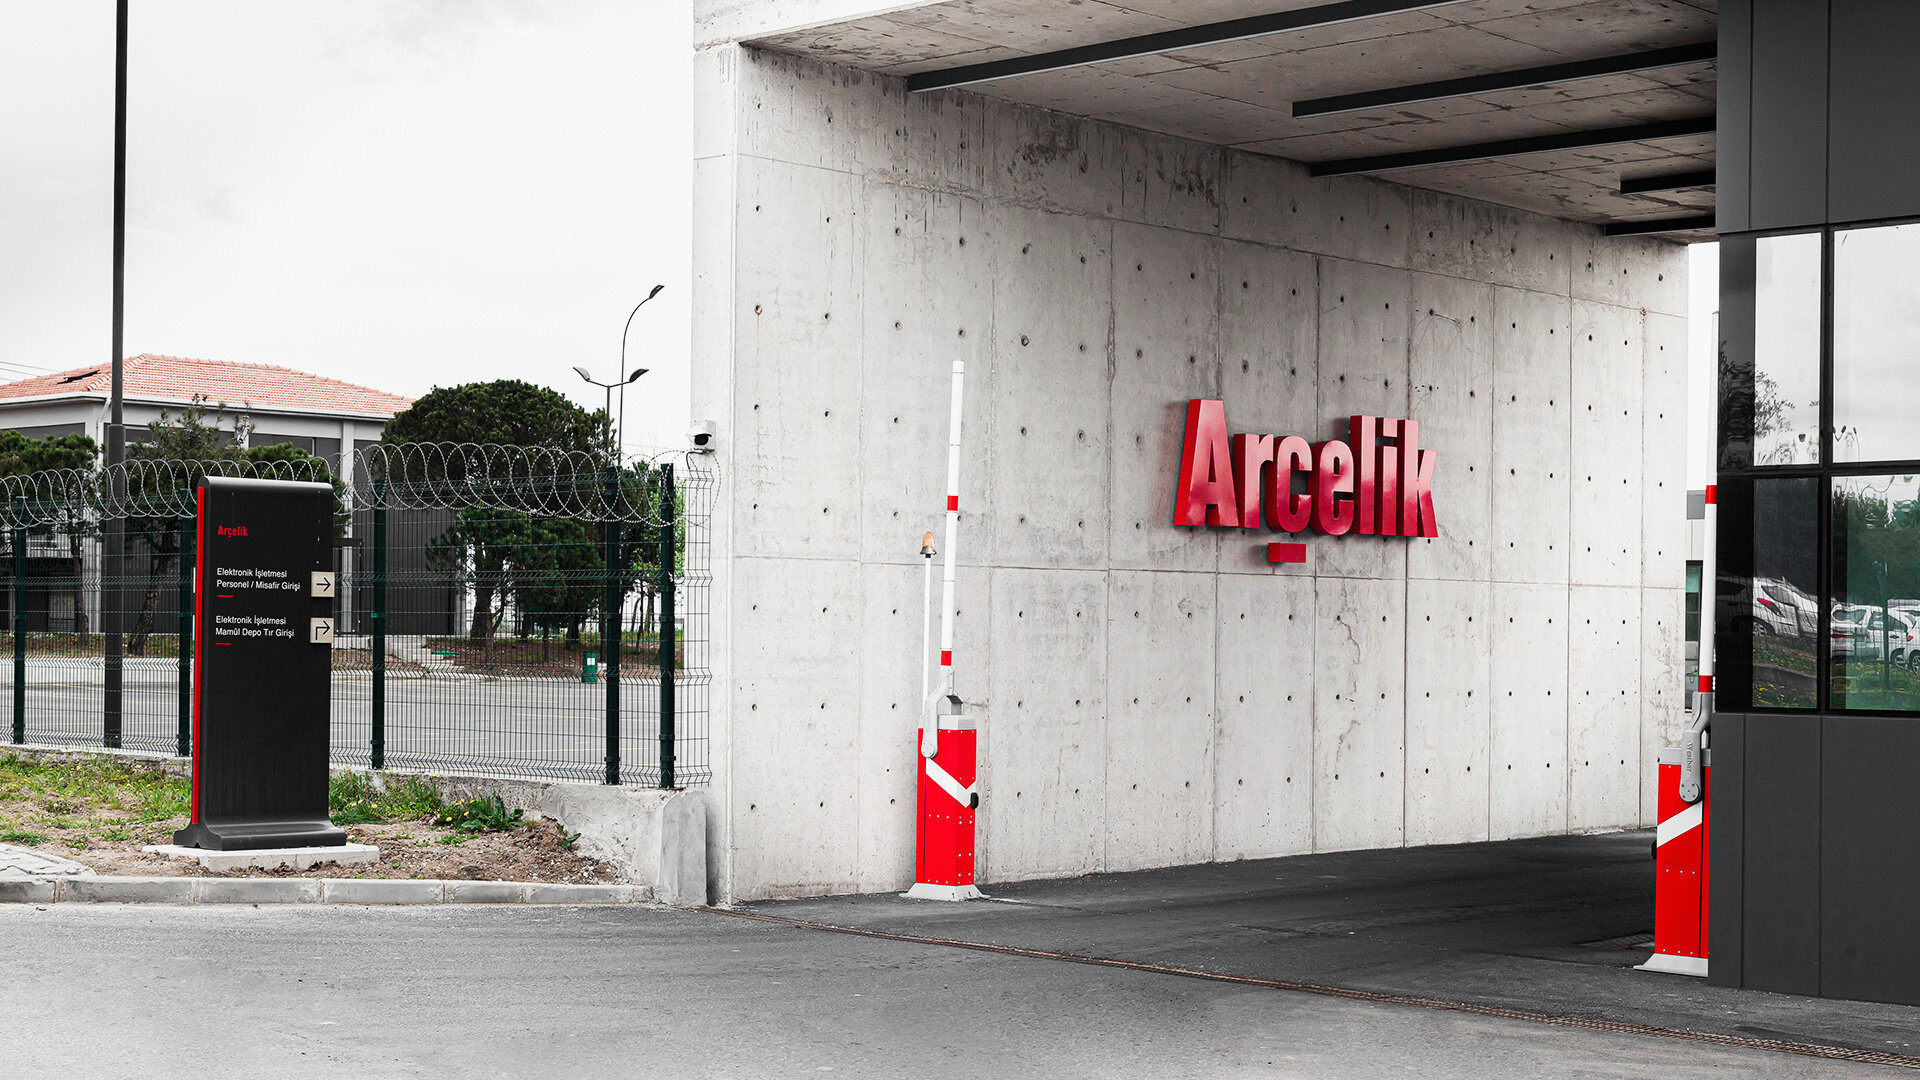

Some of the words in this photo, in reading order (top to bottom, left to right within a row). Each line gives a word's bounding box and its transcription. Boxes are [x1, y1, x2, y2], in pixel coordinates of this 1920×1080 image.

[1174, 398, 1438, 563] Arçelik
[217, 525, 248, 538] Arçelik
[217, 567, 253, 577] Elektronik
[255, 567, 287, 578] İşletmesi
[216, 580, 249, 589] Personel
[255, 581, 280, 590] Misafir
[281, 582, 300, 592] Girişi
[215, 615, 252, 625] Elektronik
[254, 615, 286, 626] İşletmesi
[242, 628, 262, 638] Depo
[264, 629, 273, 637] Tır
[276, 629, 294, 638] Girişi
